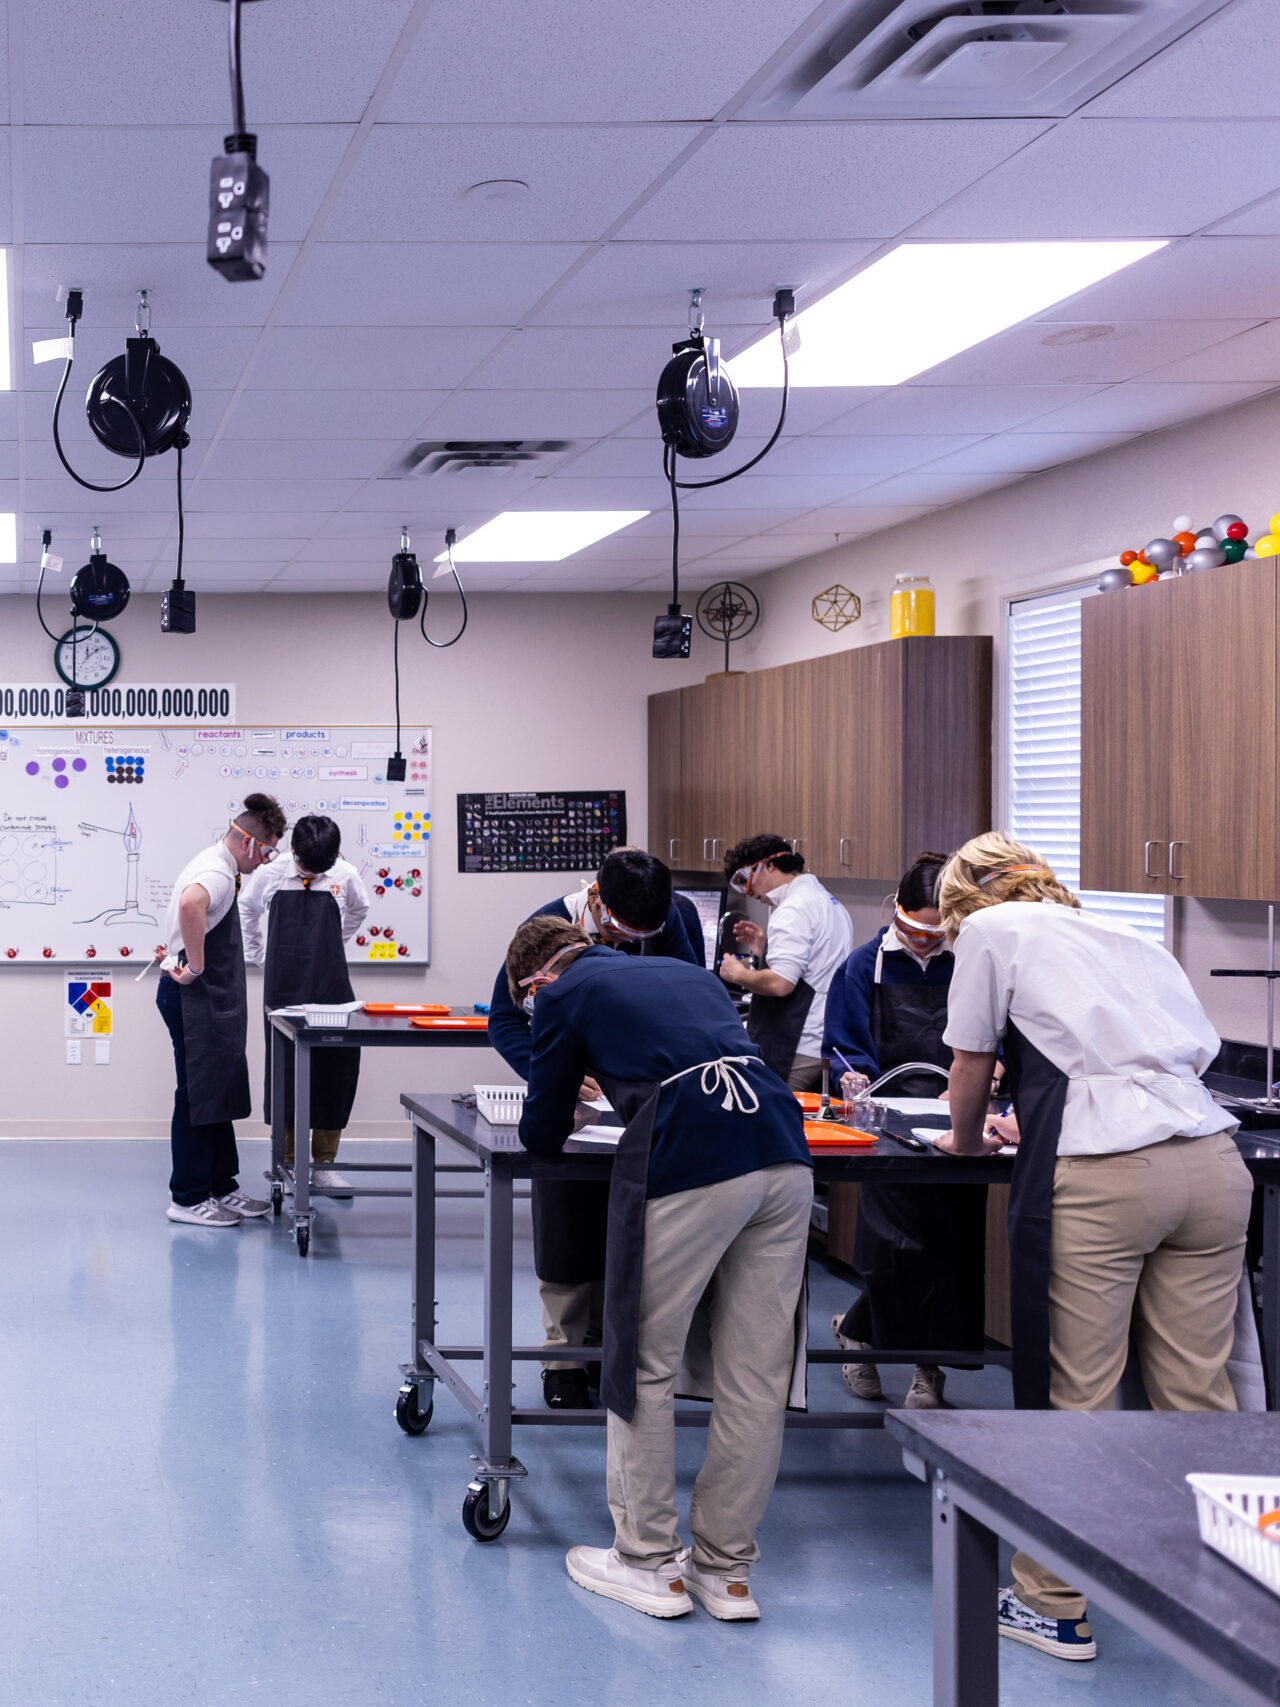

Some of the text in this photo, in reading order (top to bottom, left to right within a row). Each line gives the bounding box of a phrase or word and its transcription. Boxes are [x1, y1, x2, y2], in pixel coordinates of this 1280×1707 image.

[75, 731, 114, 744] MIXTURES
[286, 730, 325, 739] products
[104, 747, 150, 755] heterogeneous
[494, 794, 565, 809] Elements
